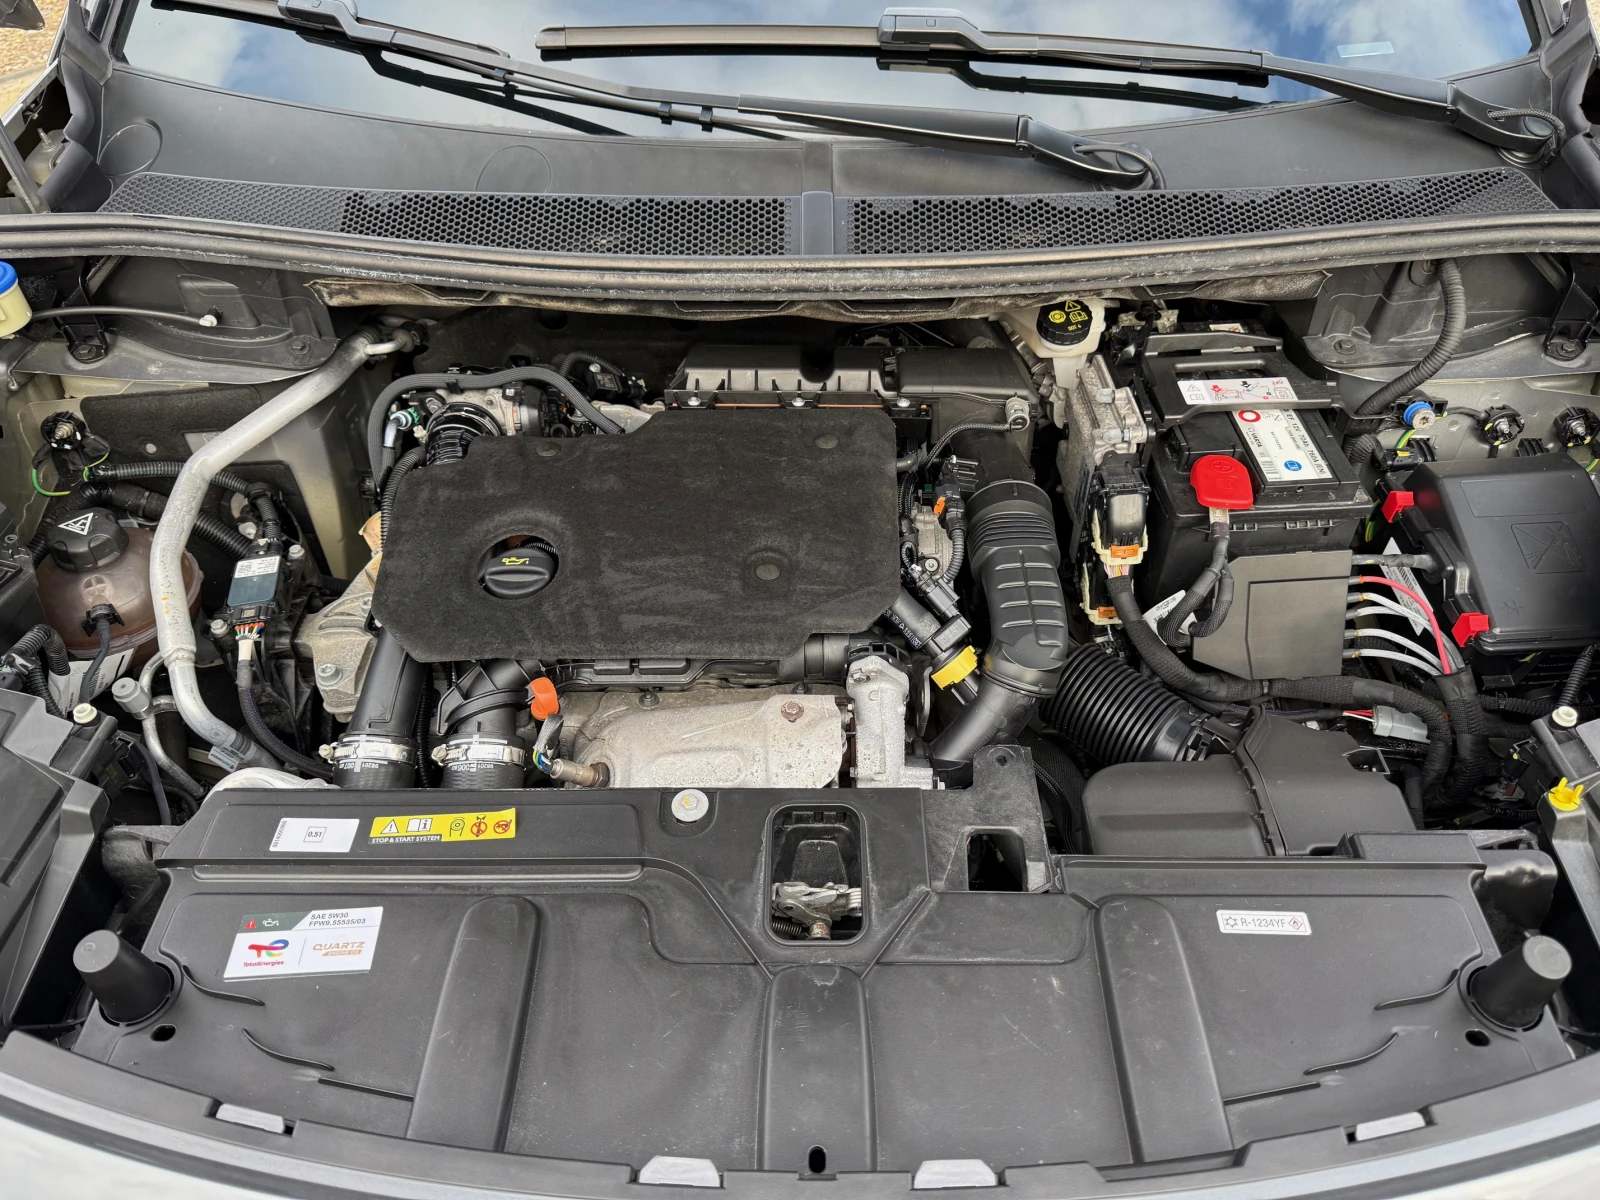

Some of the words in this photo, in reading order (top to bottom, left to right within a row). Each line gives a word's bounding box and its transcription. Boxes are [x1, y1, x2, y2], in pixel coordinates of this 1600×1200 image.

[308, 918, 366, 927] FPW9.55535/03
[1240, 917, 1286, 927] R-1234YF
[312, 941, 366, 951] QUARTZ
[243, 960, 285, 968] TotalEnergies
